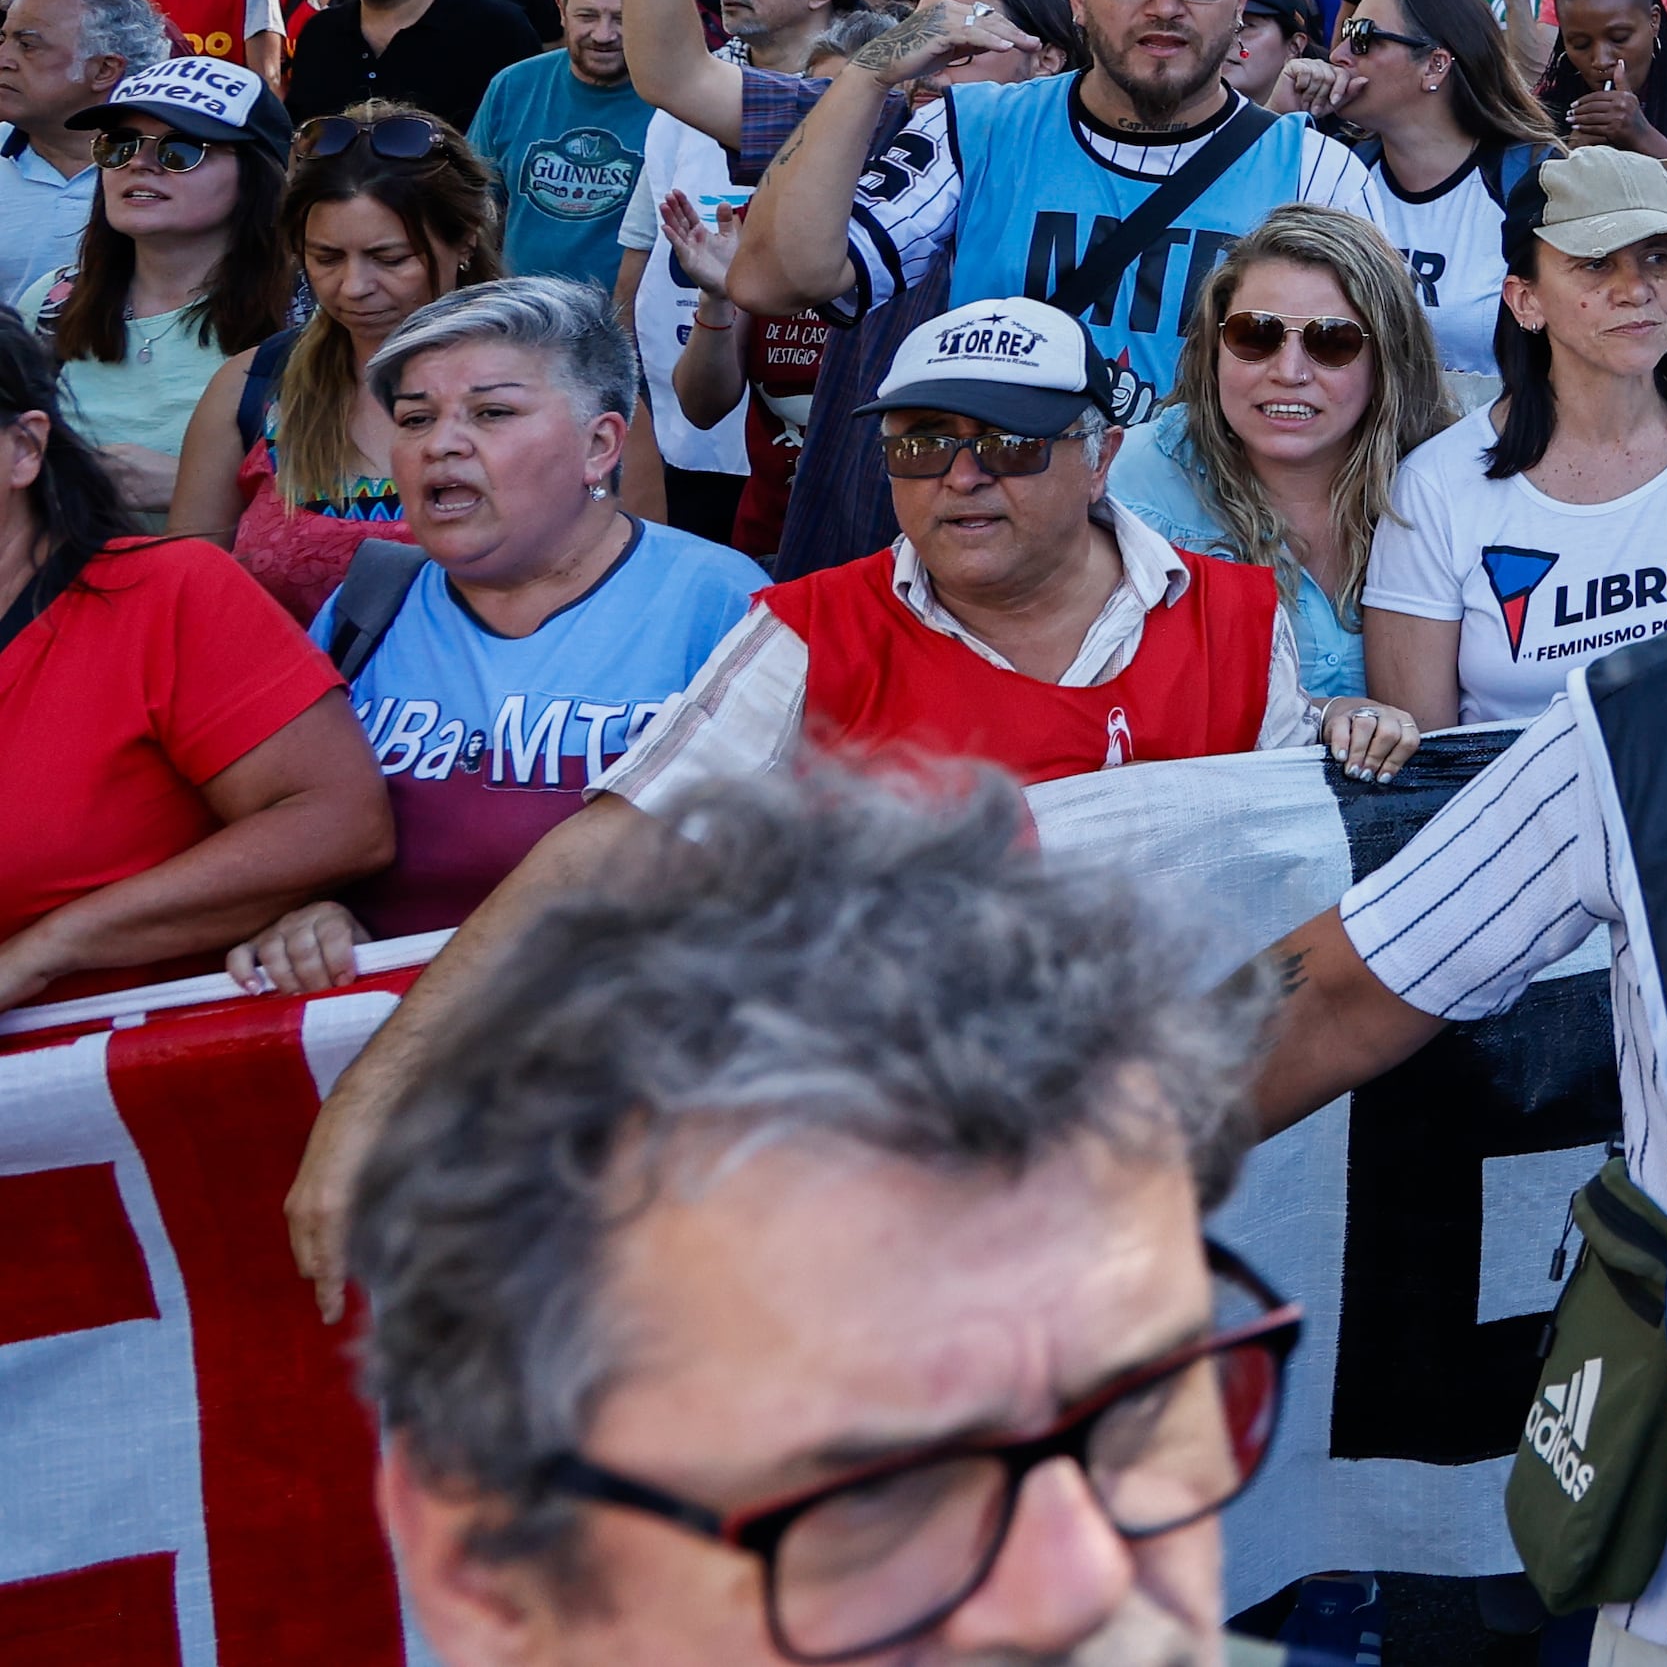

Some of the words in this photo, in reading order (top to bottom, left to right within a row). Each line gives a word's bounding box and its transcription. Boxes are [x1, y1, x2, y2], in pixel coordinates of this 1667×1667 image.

[532, 156, 633, 186] GUINNESS
[766, 323, 782, 340] DE
[785, 324, 798, 341] LA
[768, 347, 818, 365] VESTIGIO
[1537, 625, 1647, 662] FEMINISMO
[1525, 1400, 1596, 1503] adidas
